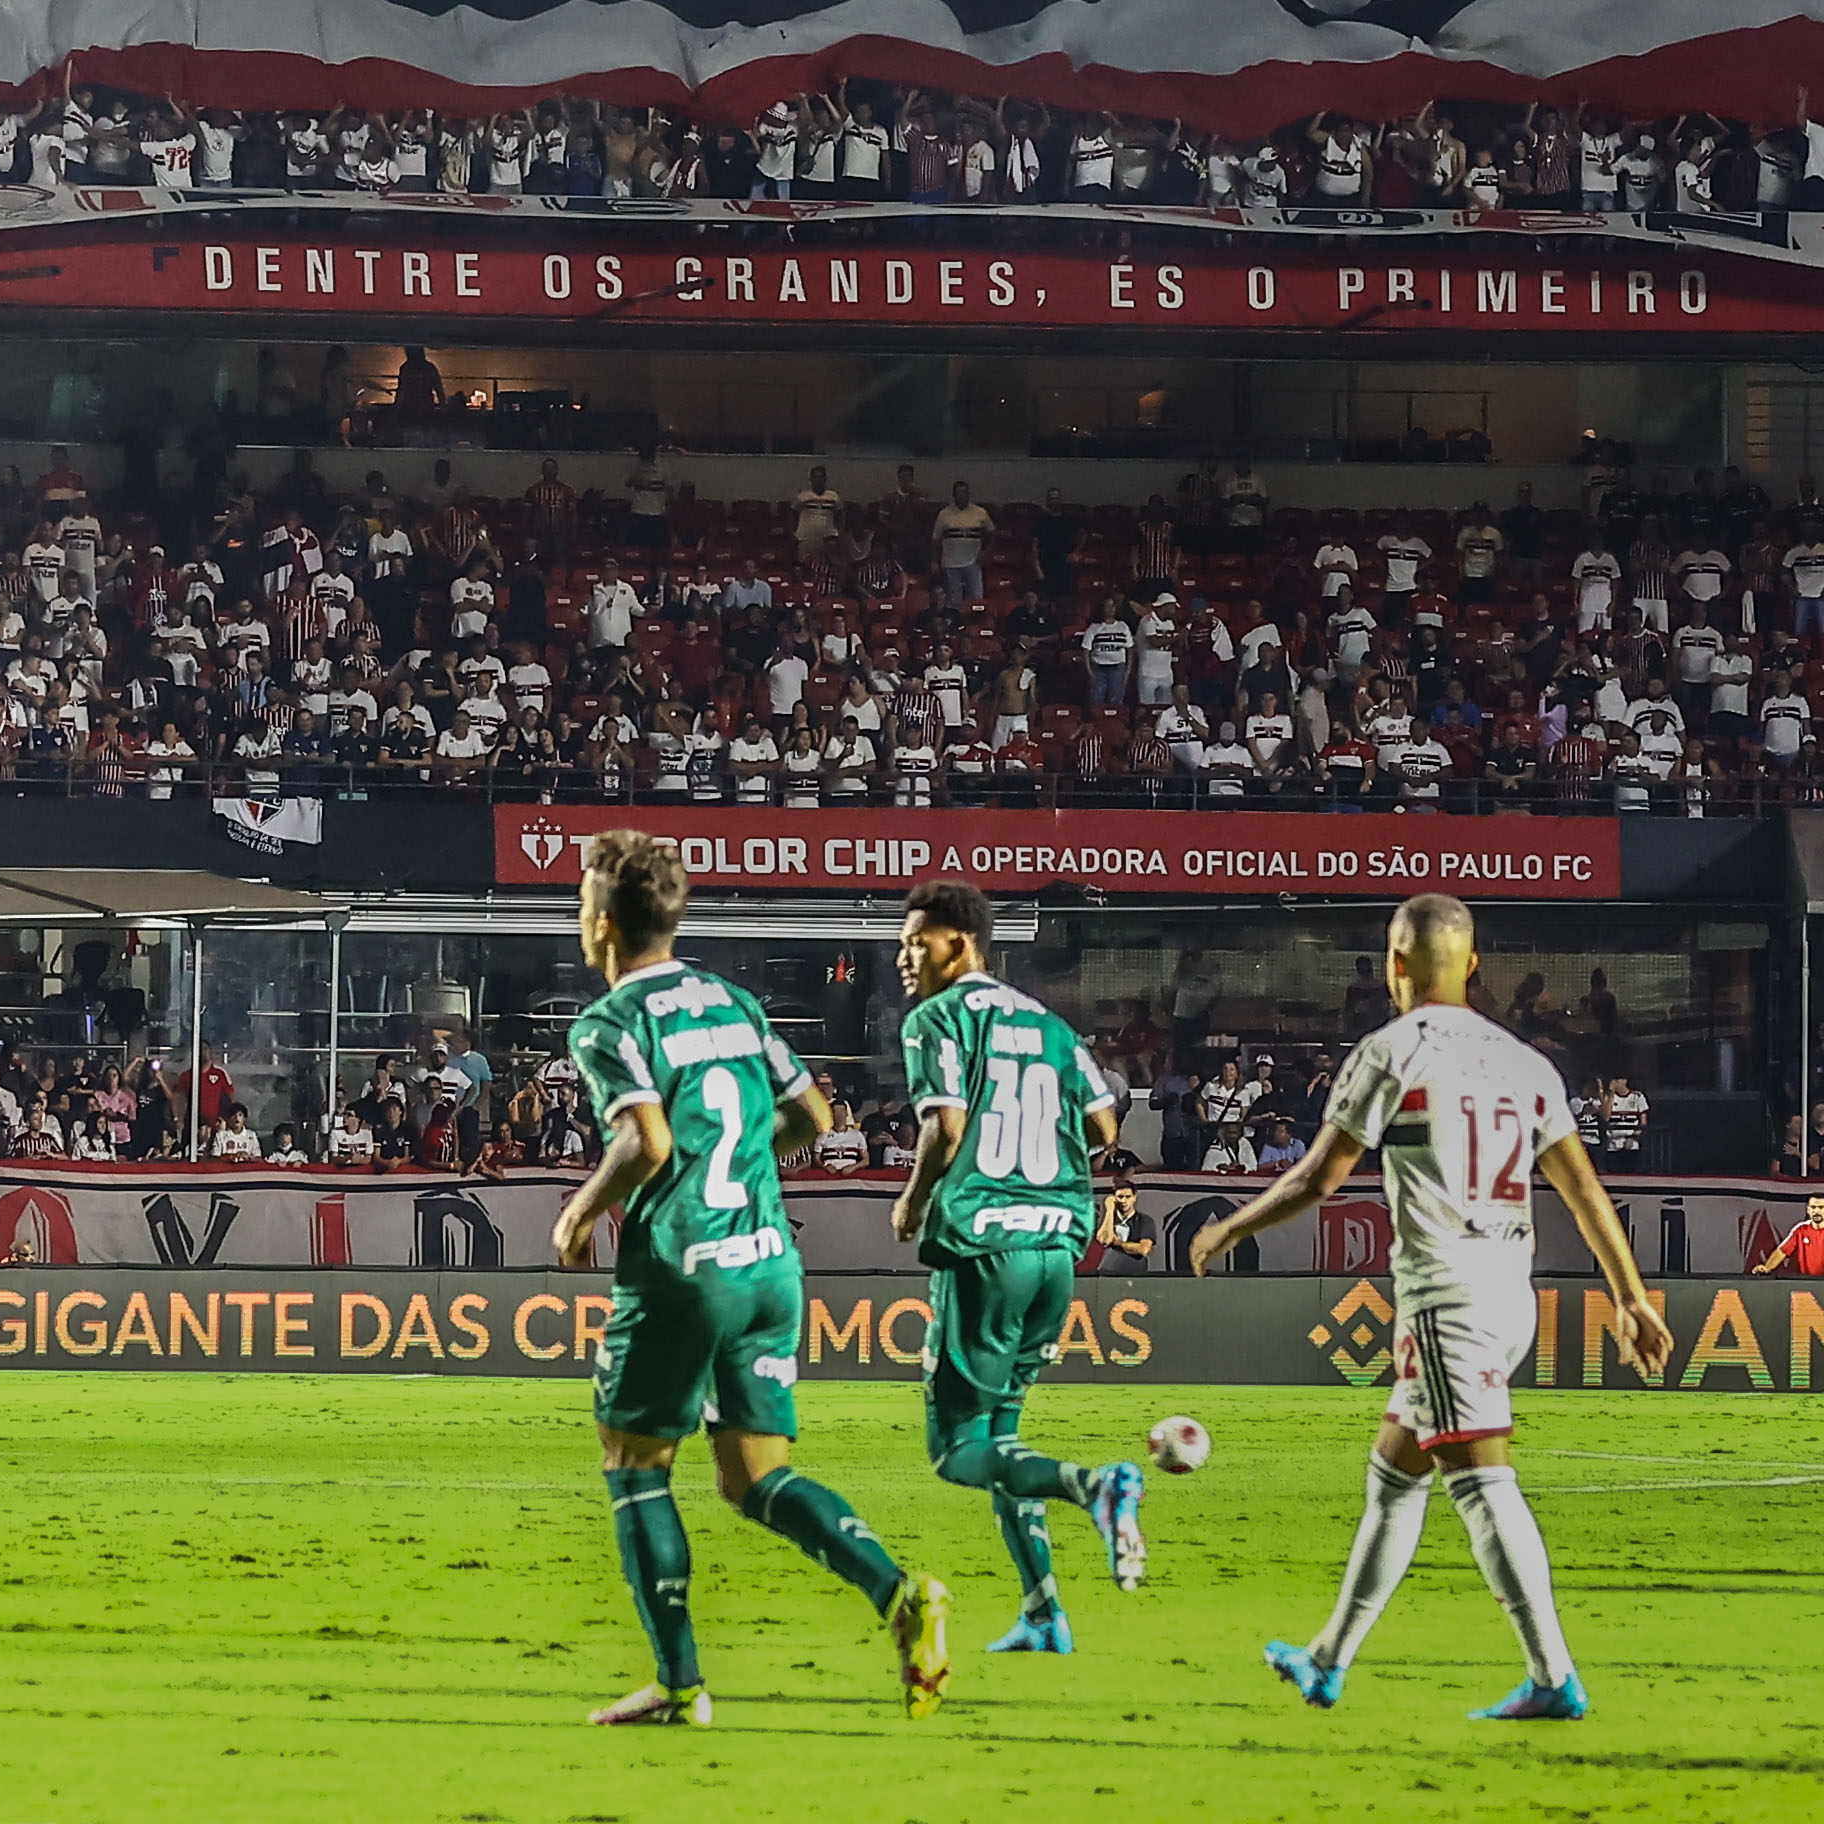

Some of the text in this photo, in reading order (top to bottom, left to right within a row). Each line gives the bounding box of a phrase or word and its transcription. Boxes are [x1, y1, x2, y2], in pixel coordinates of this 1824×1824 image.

[205, 245, 482, 297] DENTRE
[542, 253, 624, 300] OS
[675, 256, 1048, 308] GRANDES,
[1247, 265, 1276, 311] O
[1339, 266, 1709, 315] PRIMEIRO
[568, 837, 1594, 883] TOLOR CHIP A OPERADORA OFICIAL DO SÃO PAULO FC
[702, 1065, 750, 1210] 2
[976, 1060, 1061, 1186] 30
[1460, 1095, 1526, 1202] 12
[339, 1291, 491, 1362] DAS
